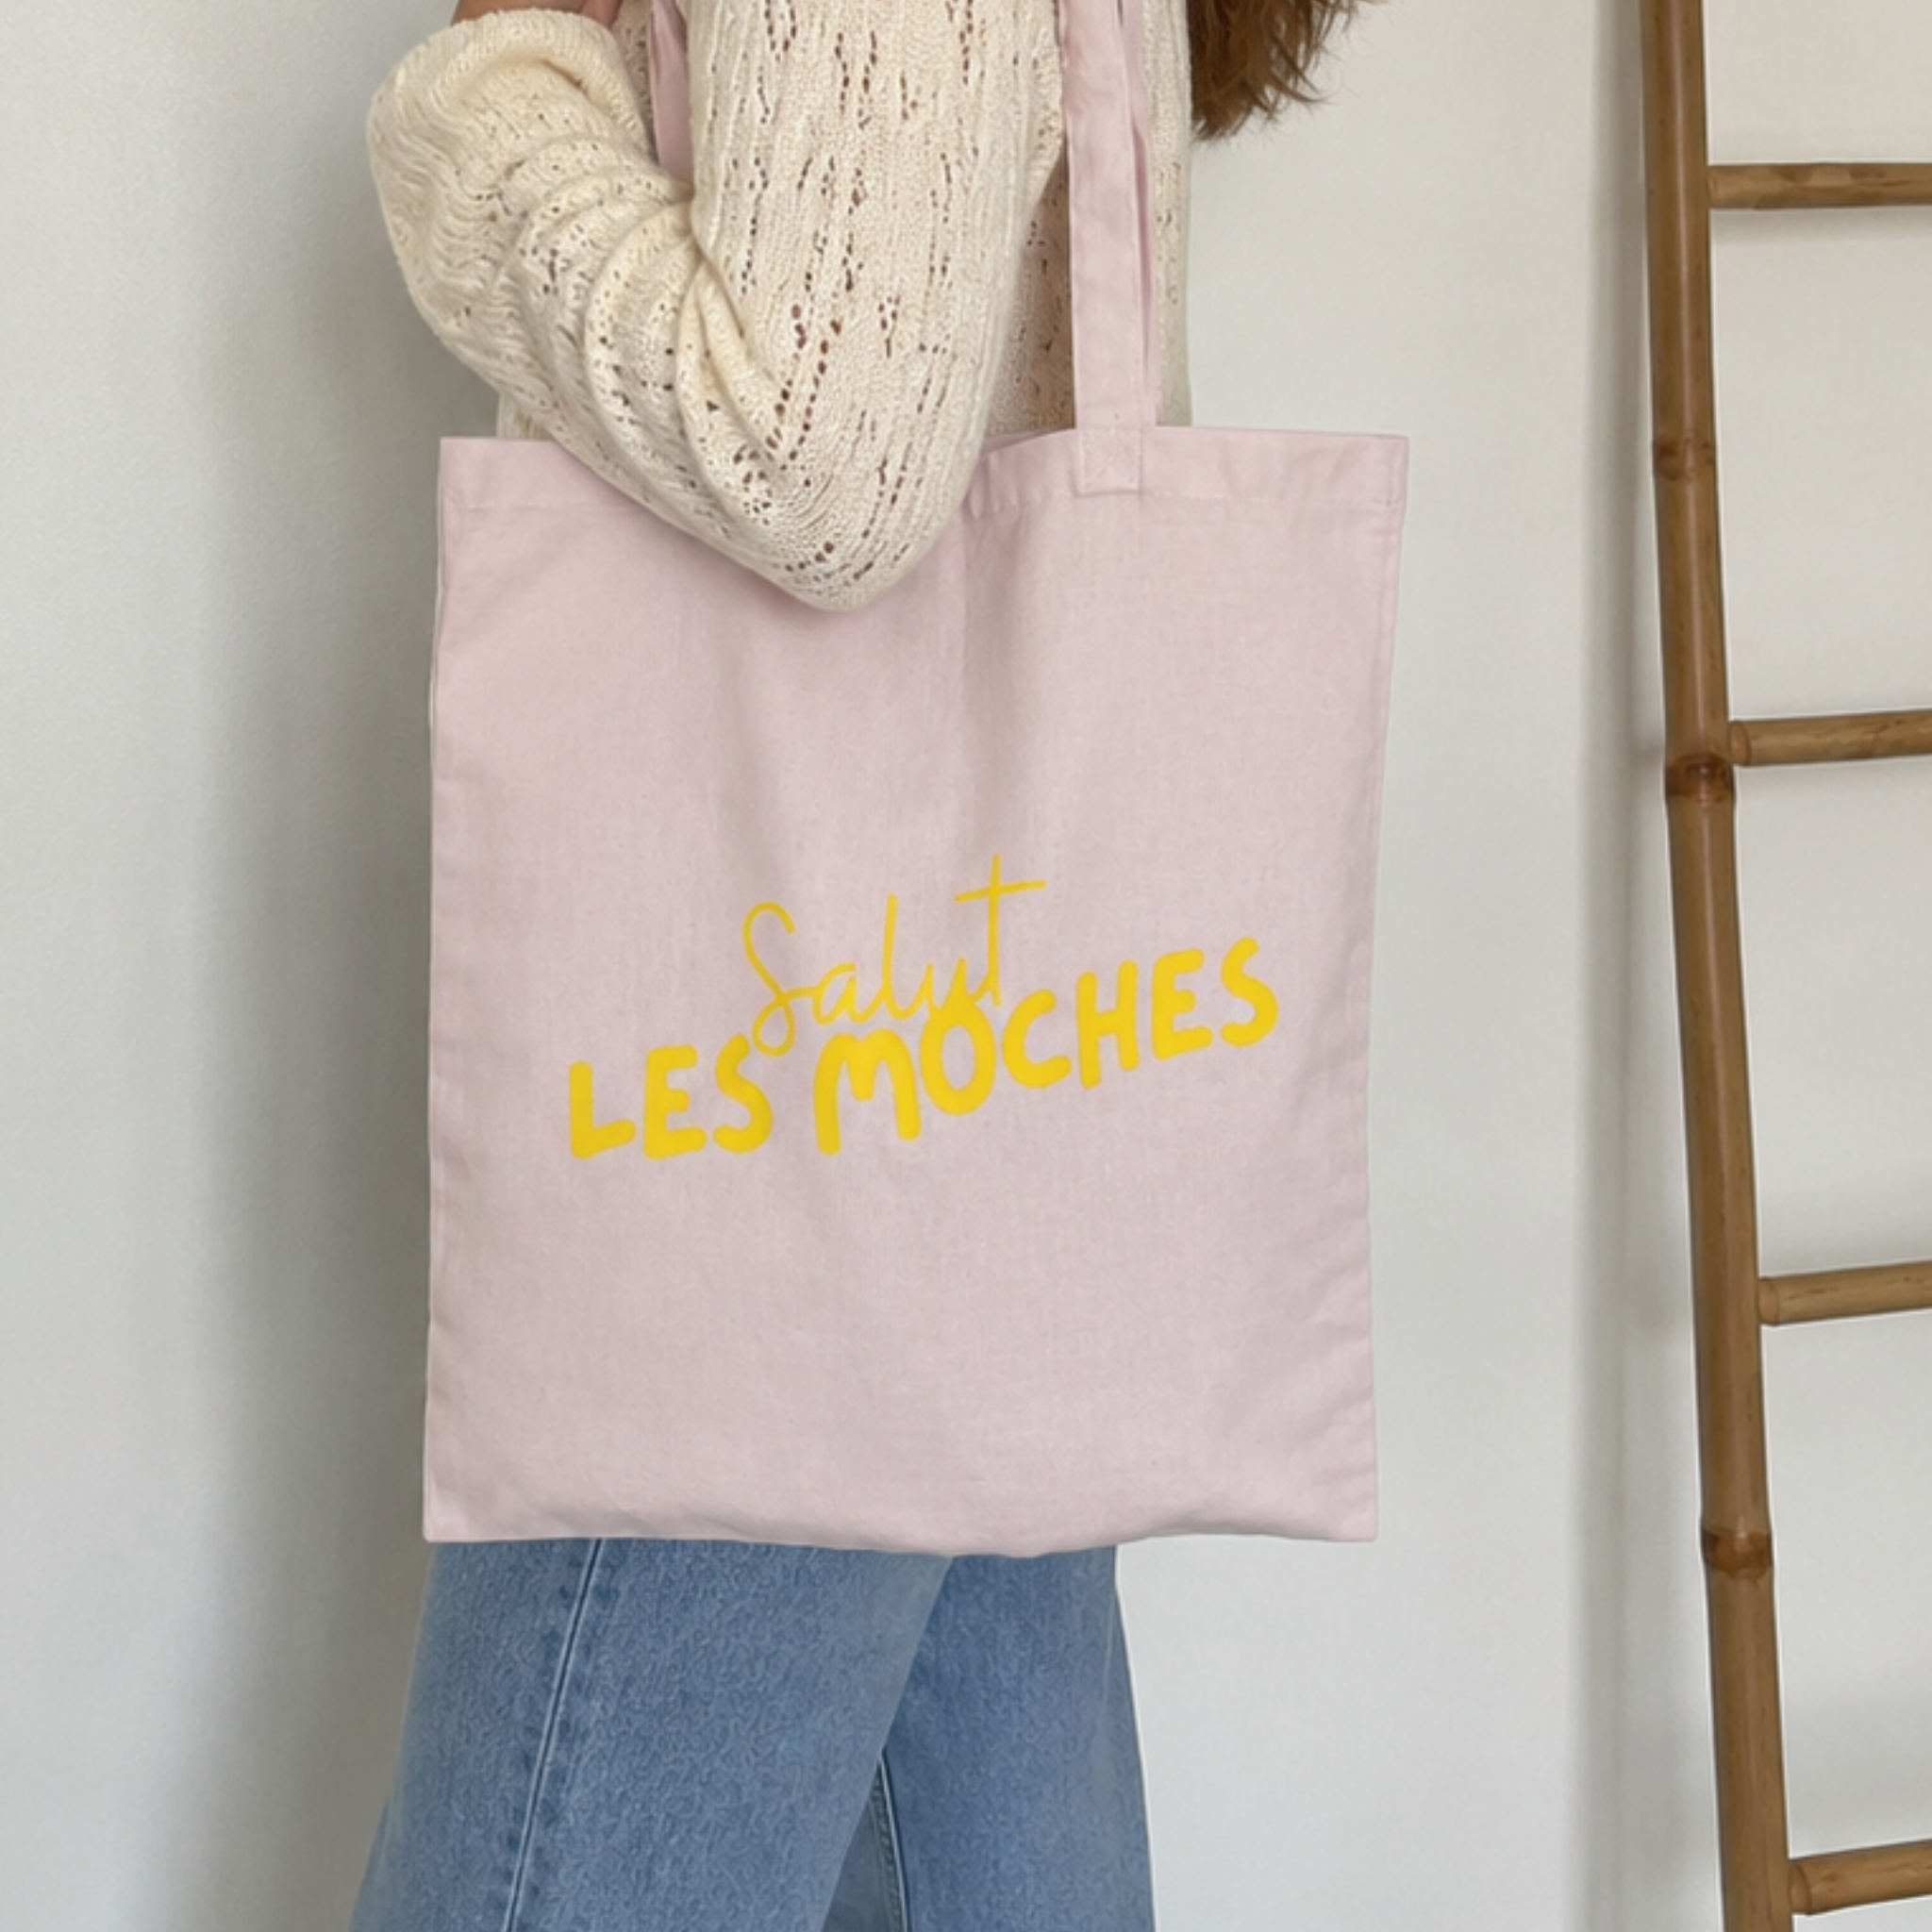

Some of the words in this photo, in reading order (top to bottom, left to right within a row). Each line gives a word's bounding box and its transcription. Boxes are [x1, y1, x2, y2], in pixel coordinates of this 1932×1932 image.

[569, 1033, 774, 1159] LES
[812, 936, 1278, 1156] MOCHES
[741, 854, 1046, 1057] Salut
